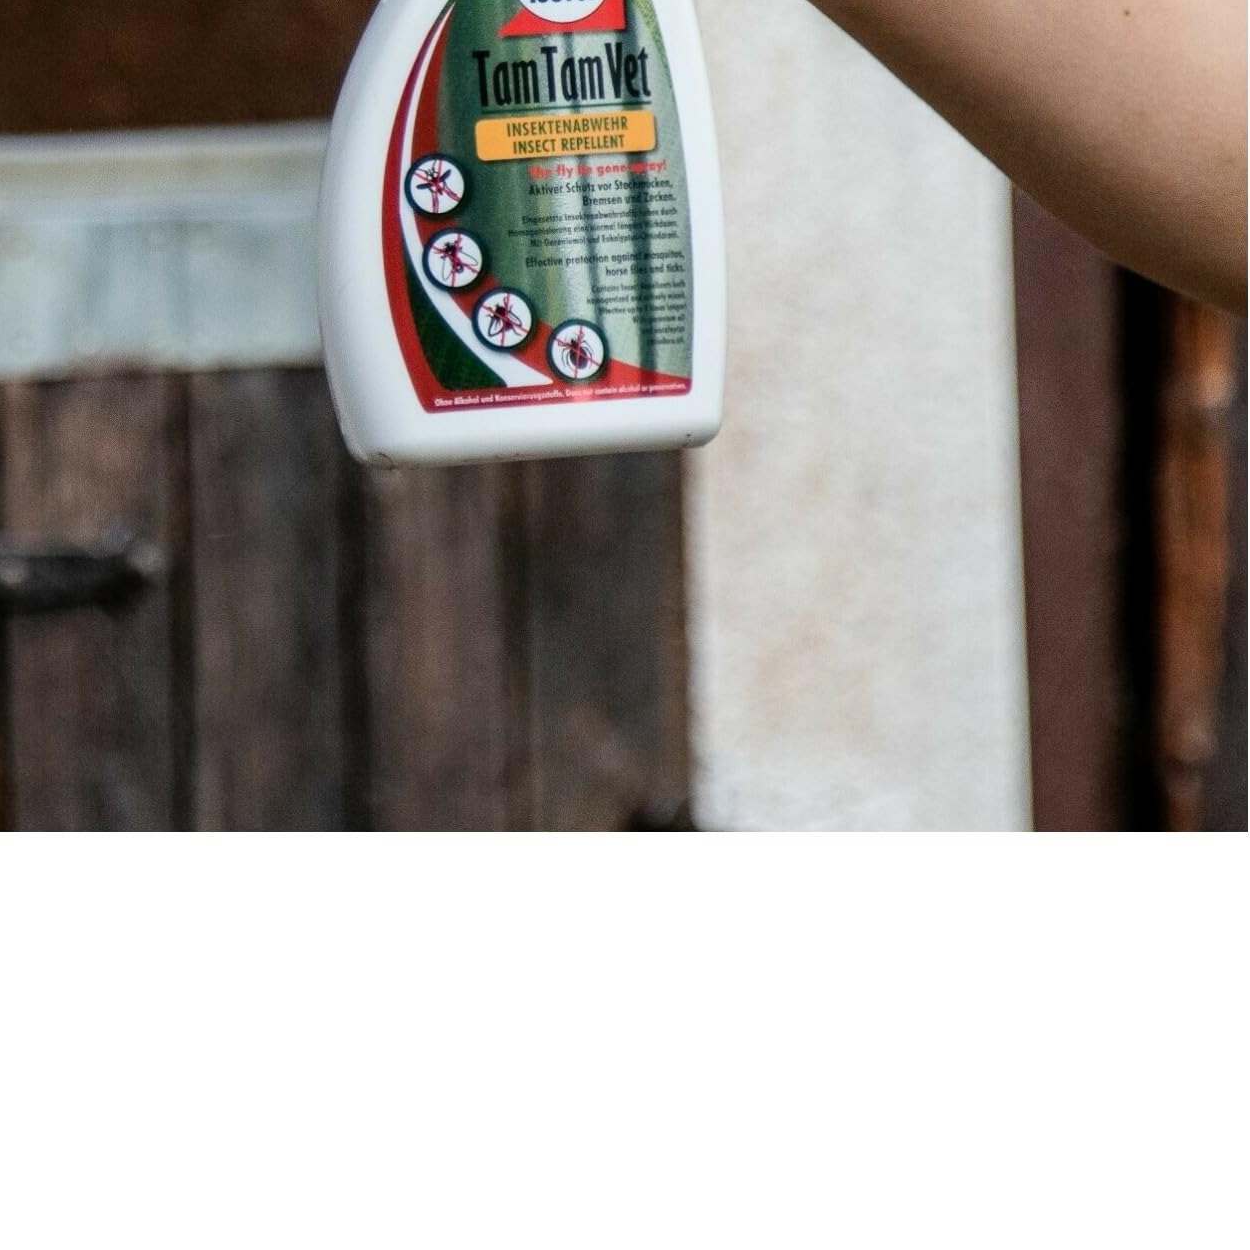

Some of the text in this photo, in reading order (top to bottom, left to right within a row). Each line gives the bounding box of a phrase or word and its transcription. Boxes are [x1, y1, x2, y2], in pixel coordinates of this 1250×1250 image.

[507, 116, 628, 137] INSEKTENABWEHR
[513, 134, 625, 154] INSECT REPELLENT
[556, 166, 573, 178] fly
[597, 165, 626, 176] gone
[529, 183, 564, 195] Aktiver
[566, 181, 595, 193] Schutz
[598, 182, 612, 191] vor
[583, 195, 622, 206] Bremsen
[626, 195, 640, 204] und
[526, 257, 563, 268] Effective
[566, 254, 609, 268] protection
[606, 266, 628, 277] horse
